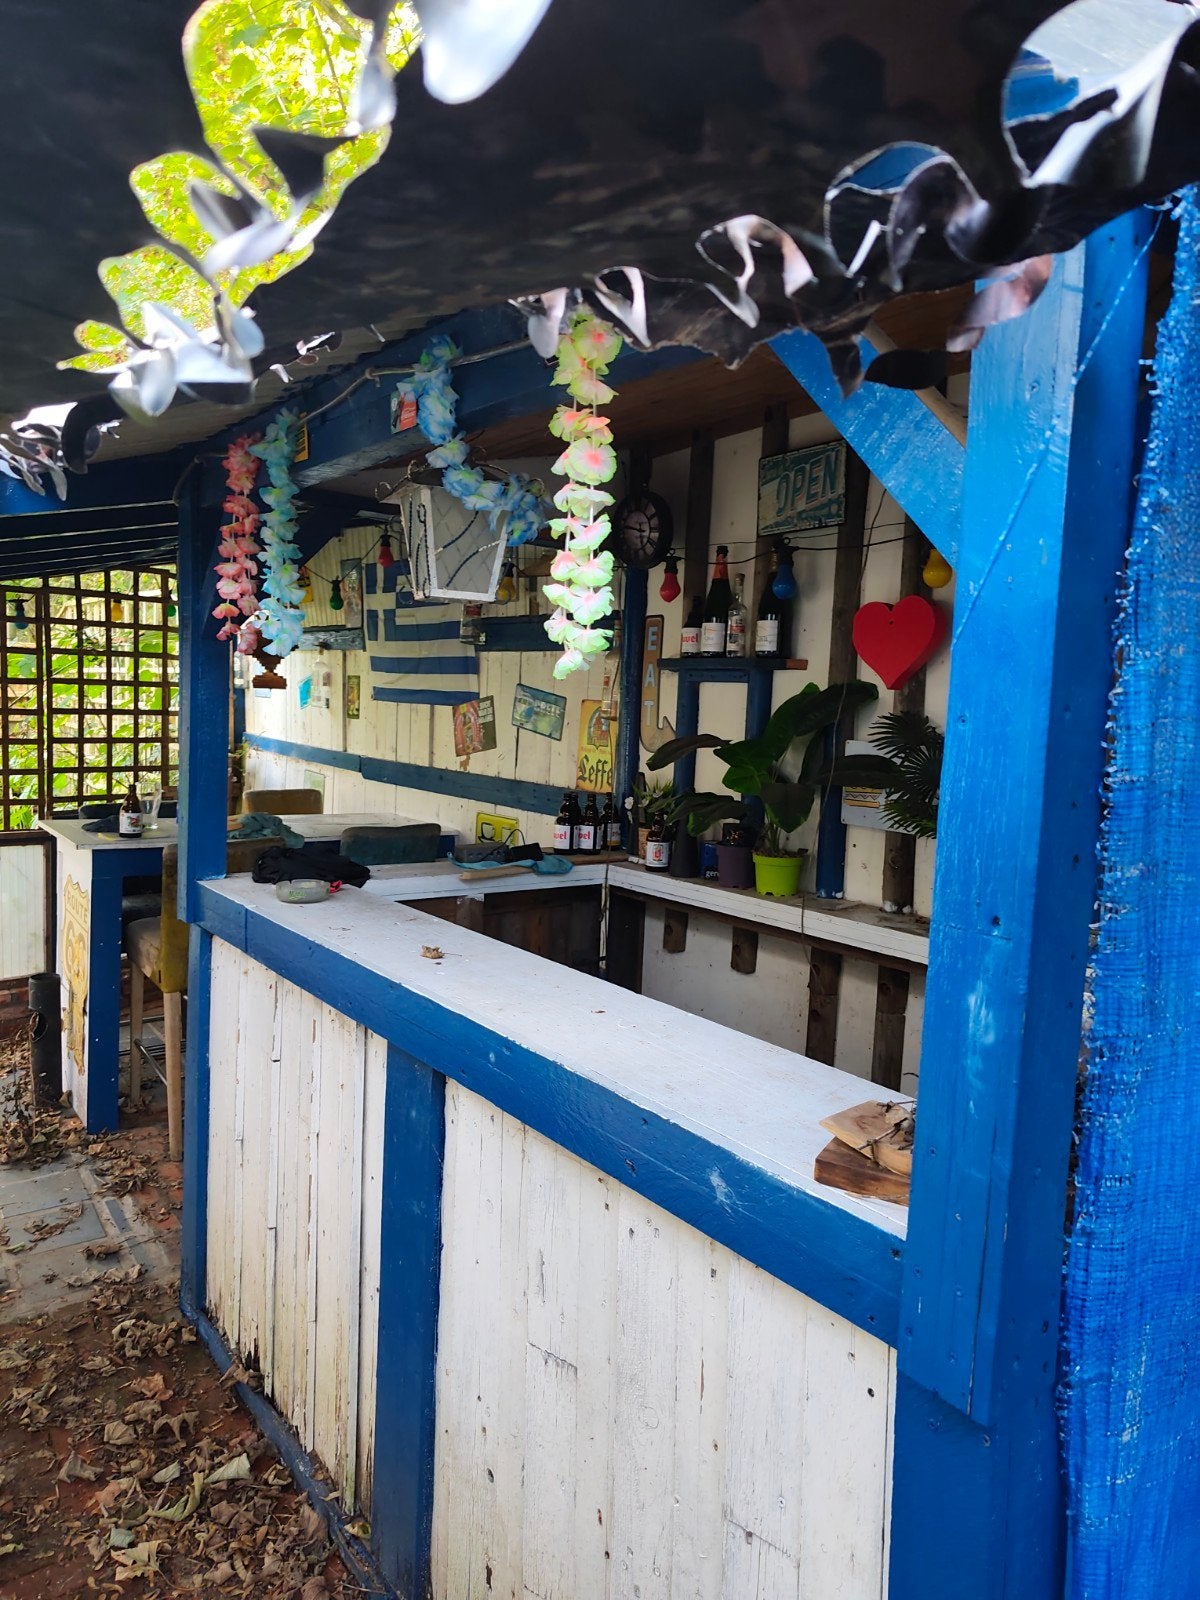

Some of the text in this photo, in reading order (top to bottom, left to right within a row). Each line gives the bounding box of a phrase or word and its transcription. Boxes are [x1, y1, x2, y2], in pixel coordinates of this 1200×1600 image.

[776, 447, 841, 517] OPEN
[644, 626, 658, 726] EAT
[577, 754, 613, 791] Leffe
[66, 889, 89, 926] ROUTE
